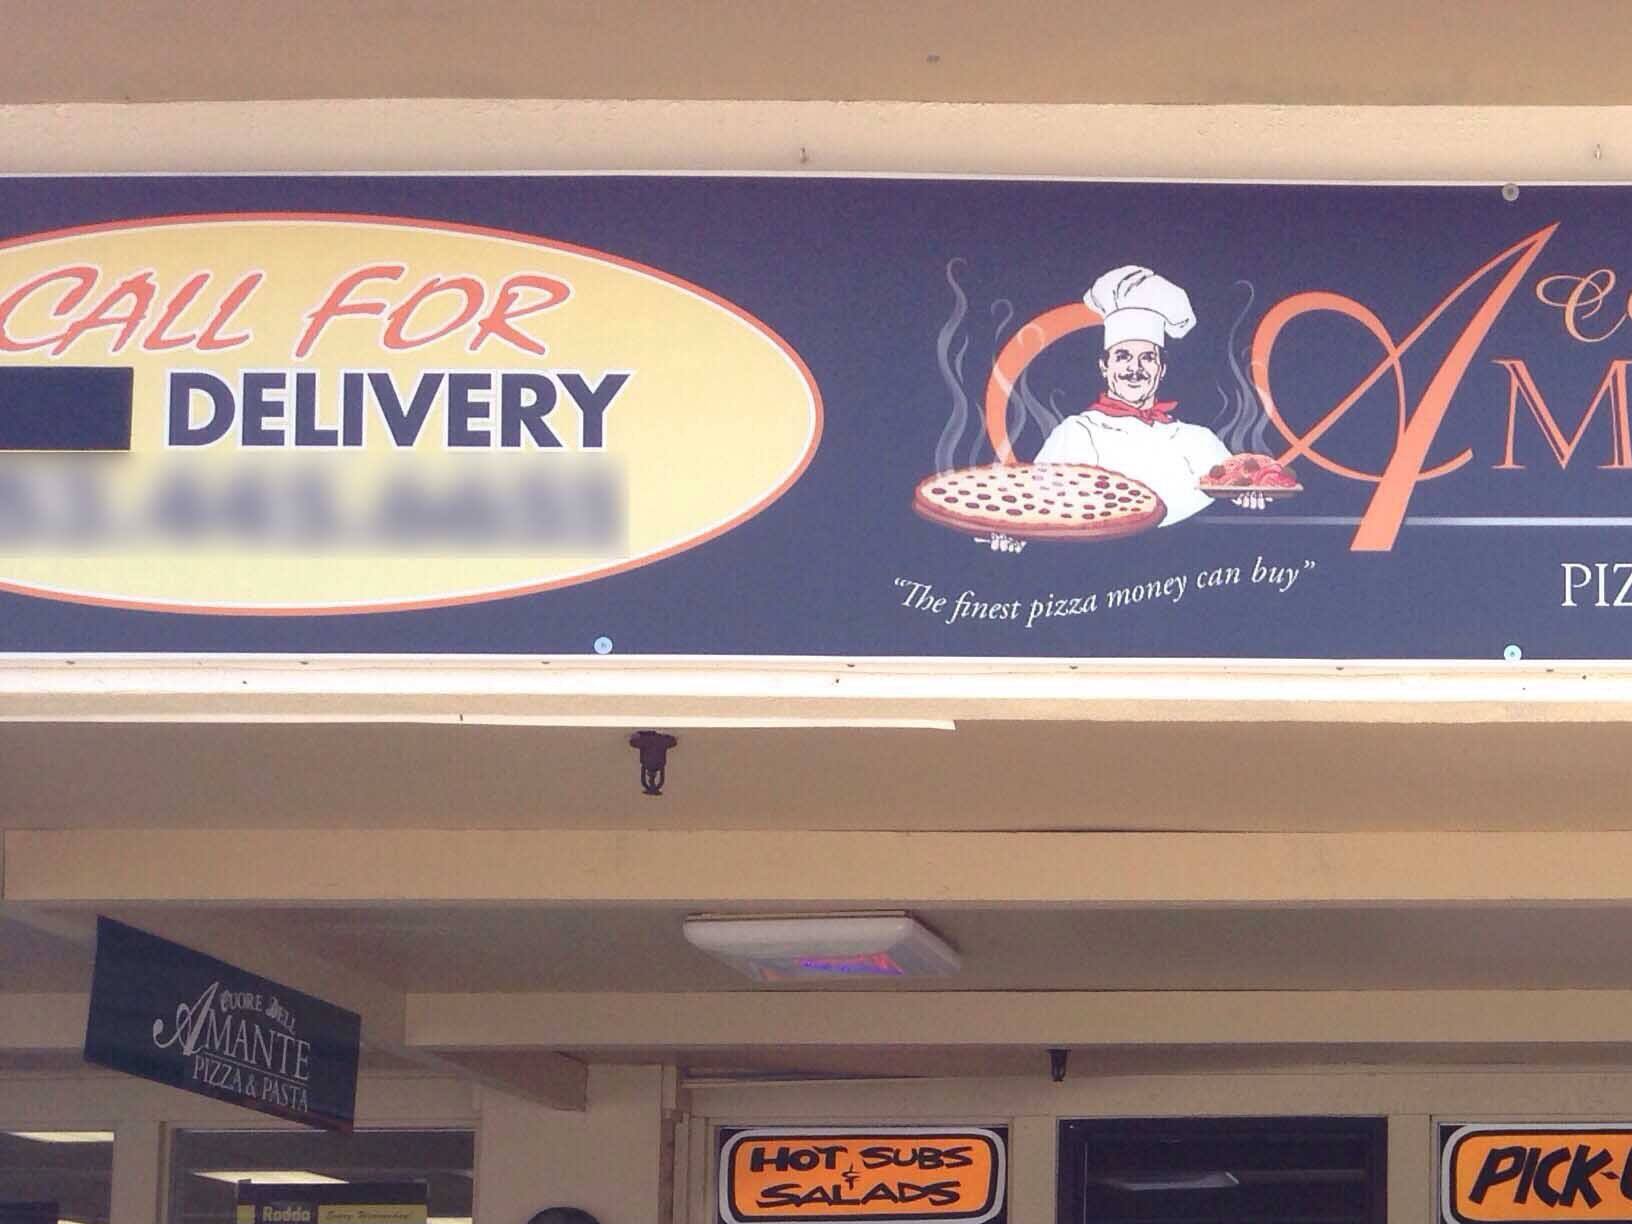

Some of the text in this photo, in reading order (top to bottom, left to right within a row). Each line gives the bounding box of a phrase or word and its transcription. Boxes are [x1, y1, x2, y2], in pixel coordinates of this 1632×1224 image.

[0, 264, 572, 358] CALL FOR
[167, 371, 631, 449] DELIVERY
[946, 590, 1021, 624] finest
[1026, 590, 1099, 628] pizza
[1106, 575, 1188, 609] money
[1196, 562, 1241, 590] can
[192, 1054, 242, 1096] PIZZA
[262, 1077, 309, 1113] PASTA
[750, 1145, 973, 1172] HOT SUBS
[756, 1180, 961, 1208] SALADS
